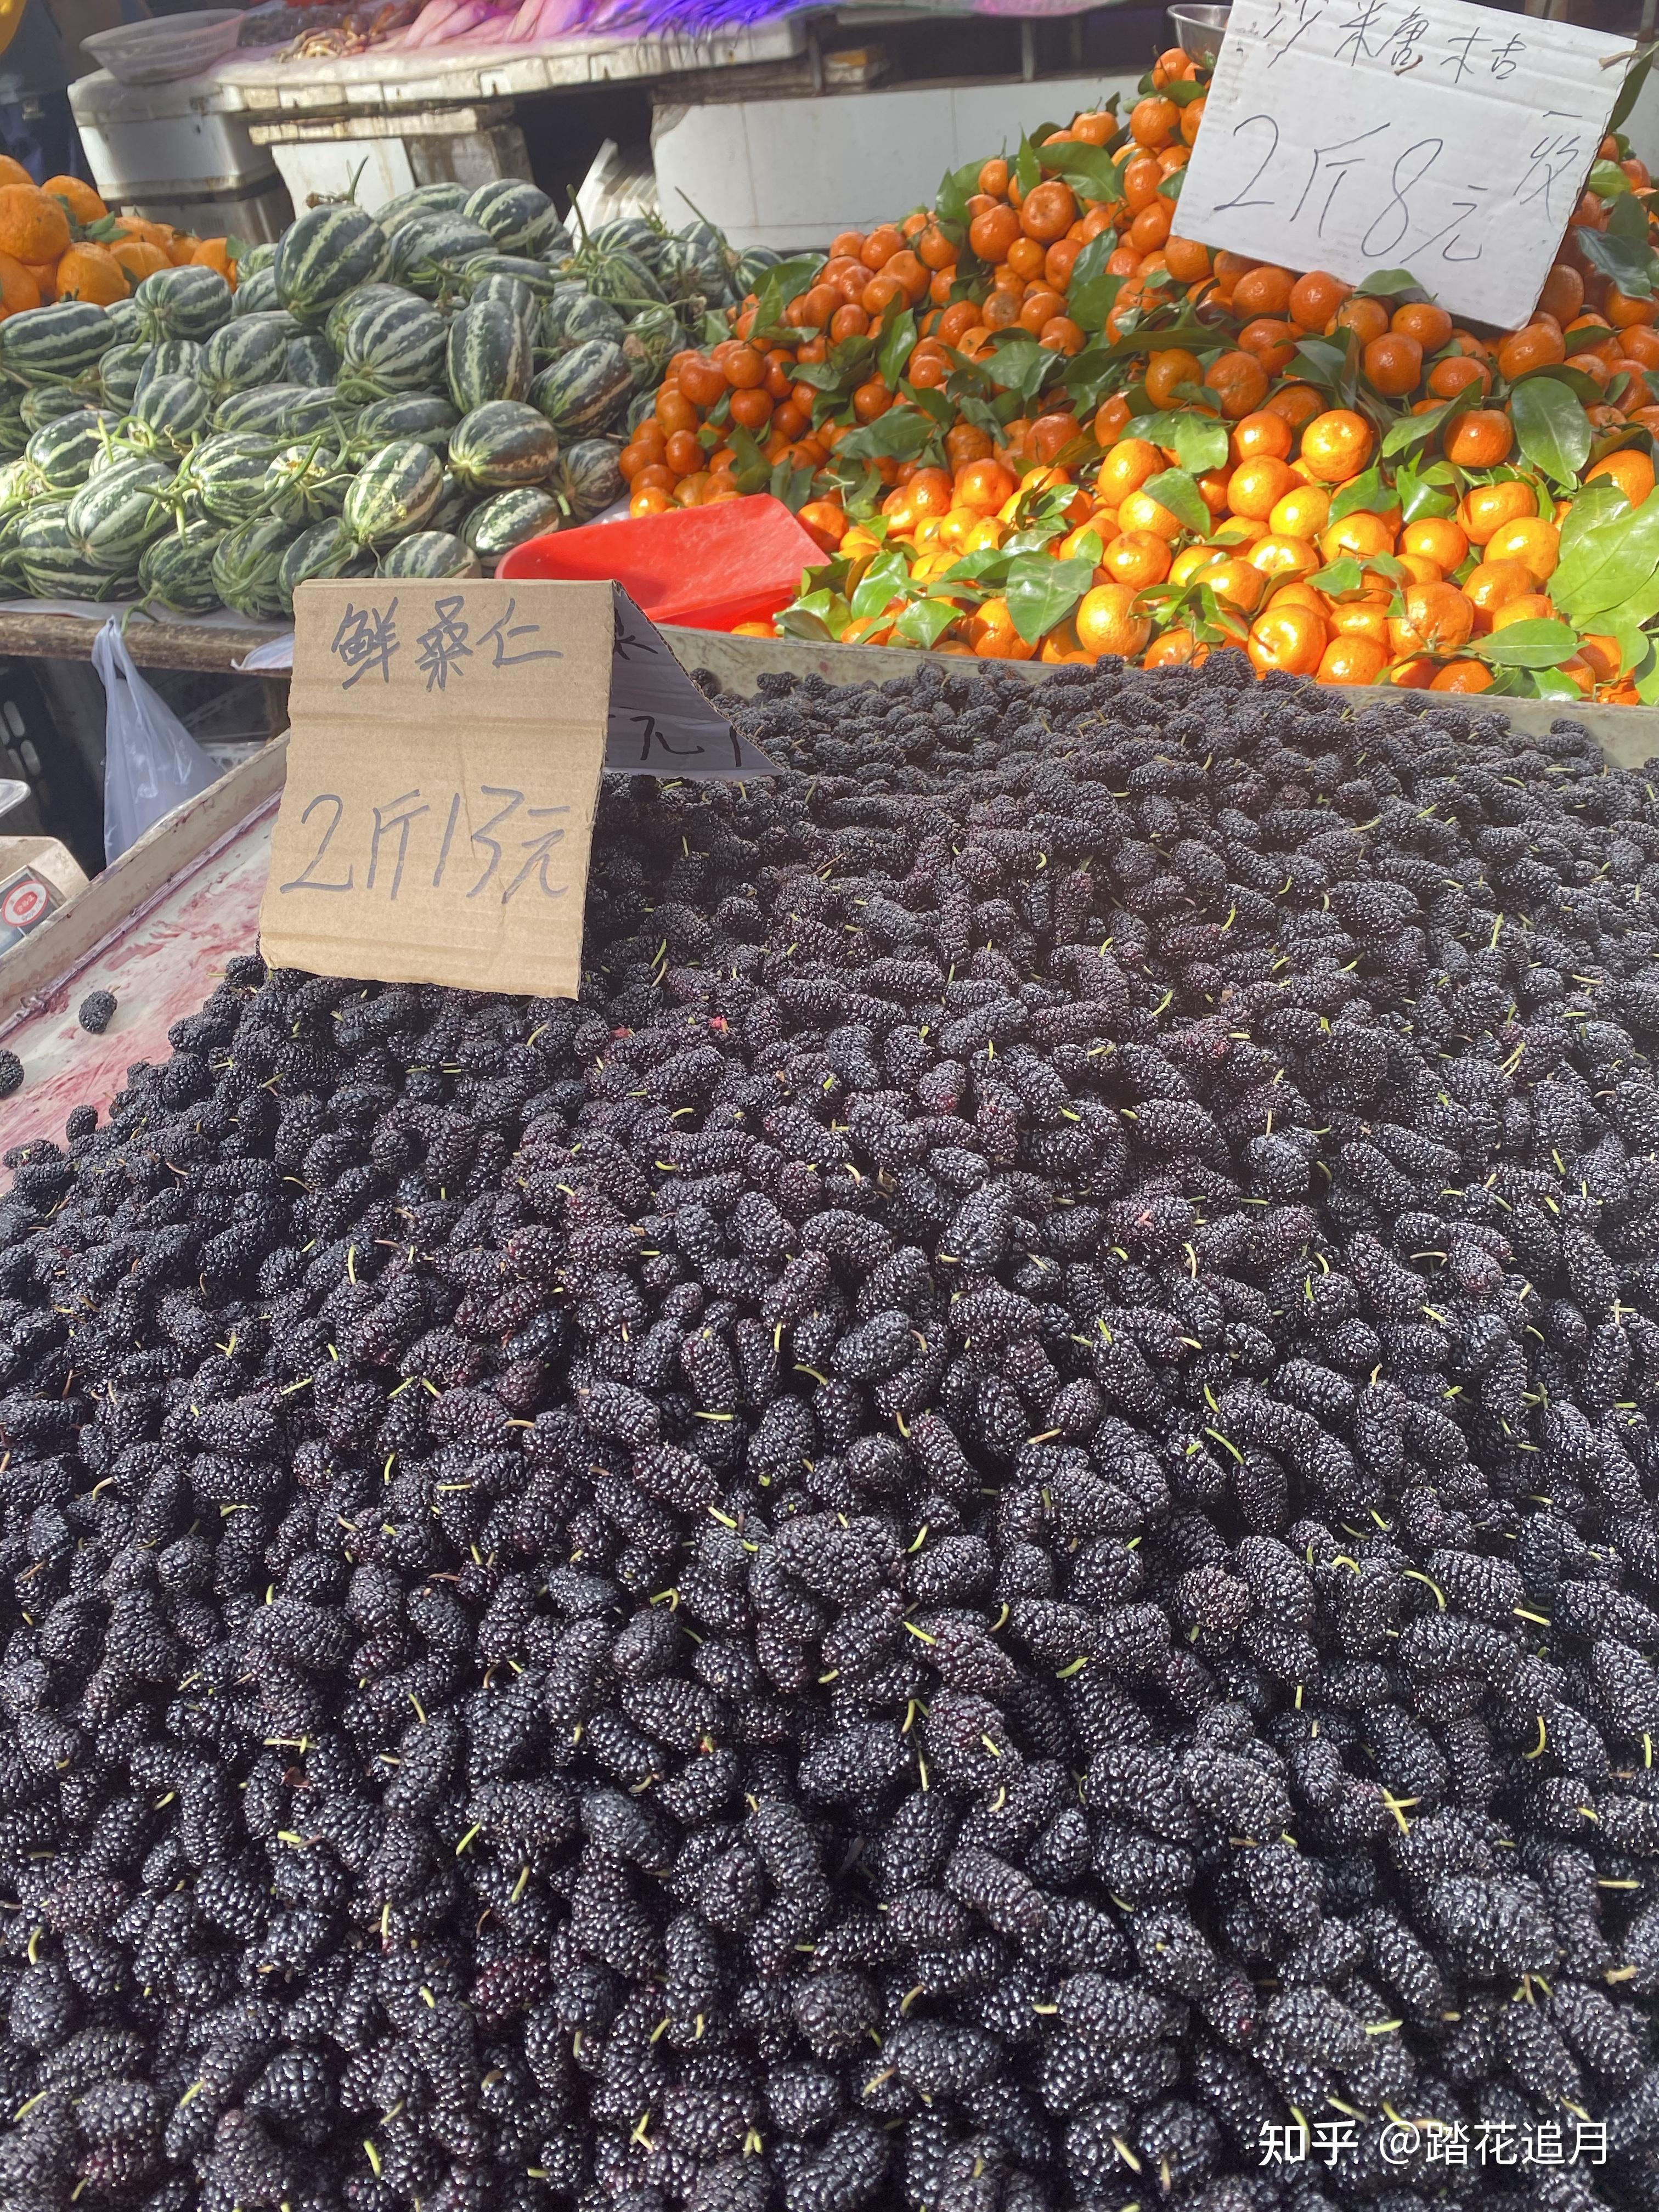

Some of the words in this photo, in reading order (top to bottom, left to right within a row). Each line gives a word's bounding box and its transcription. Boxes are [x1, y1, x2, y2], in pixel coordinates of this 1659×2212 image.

[1214, 114, 1488, 263] 2斤8元
[331, 595, 564, 692] 鲜桑仁
[280, 785, 571, 904] 2斤13元
